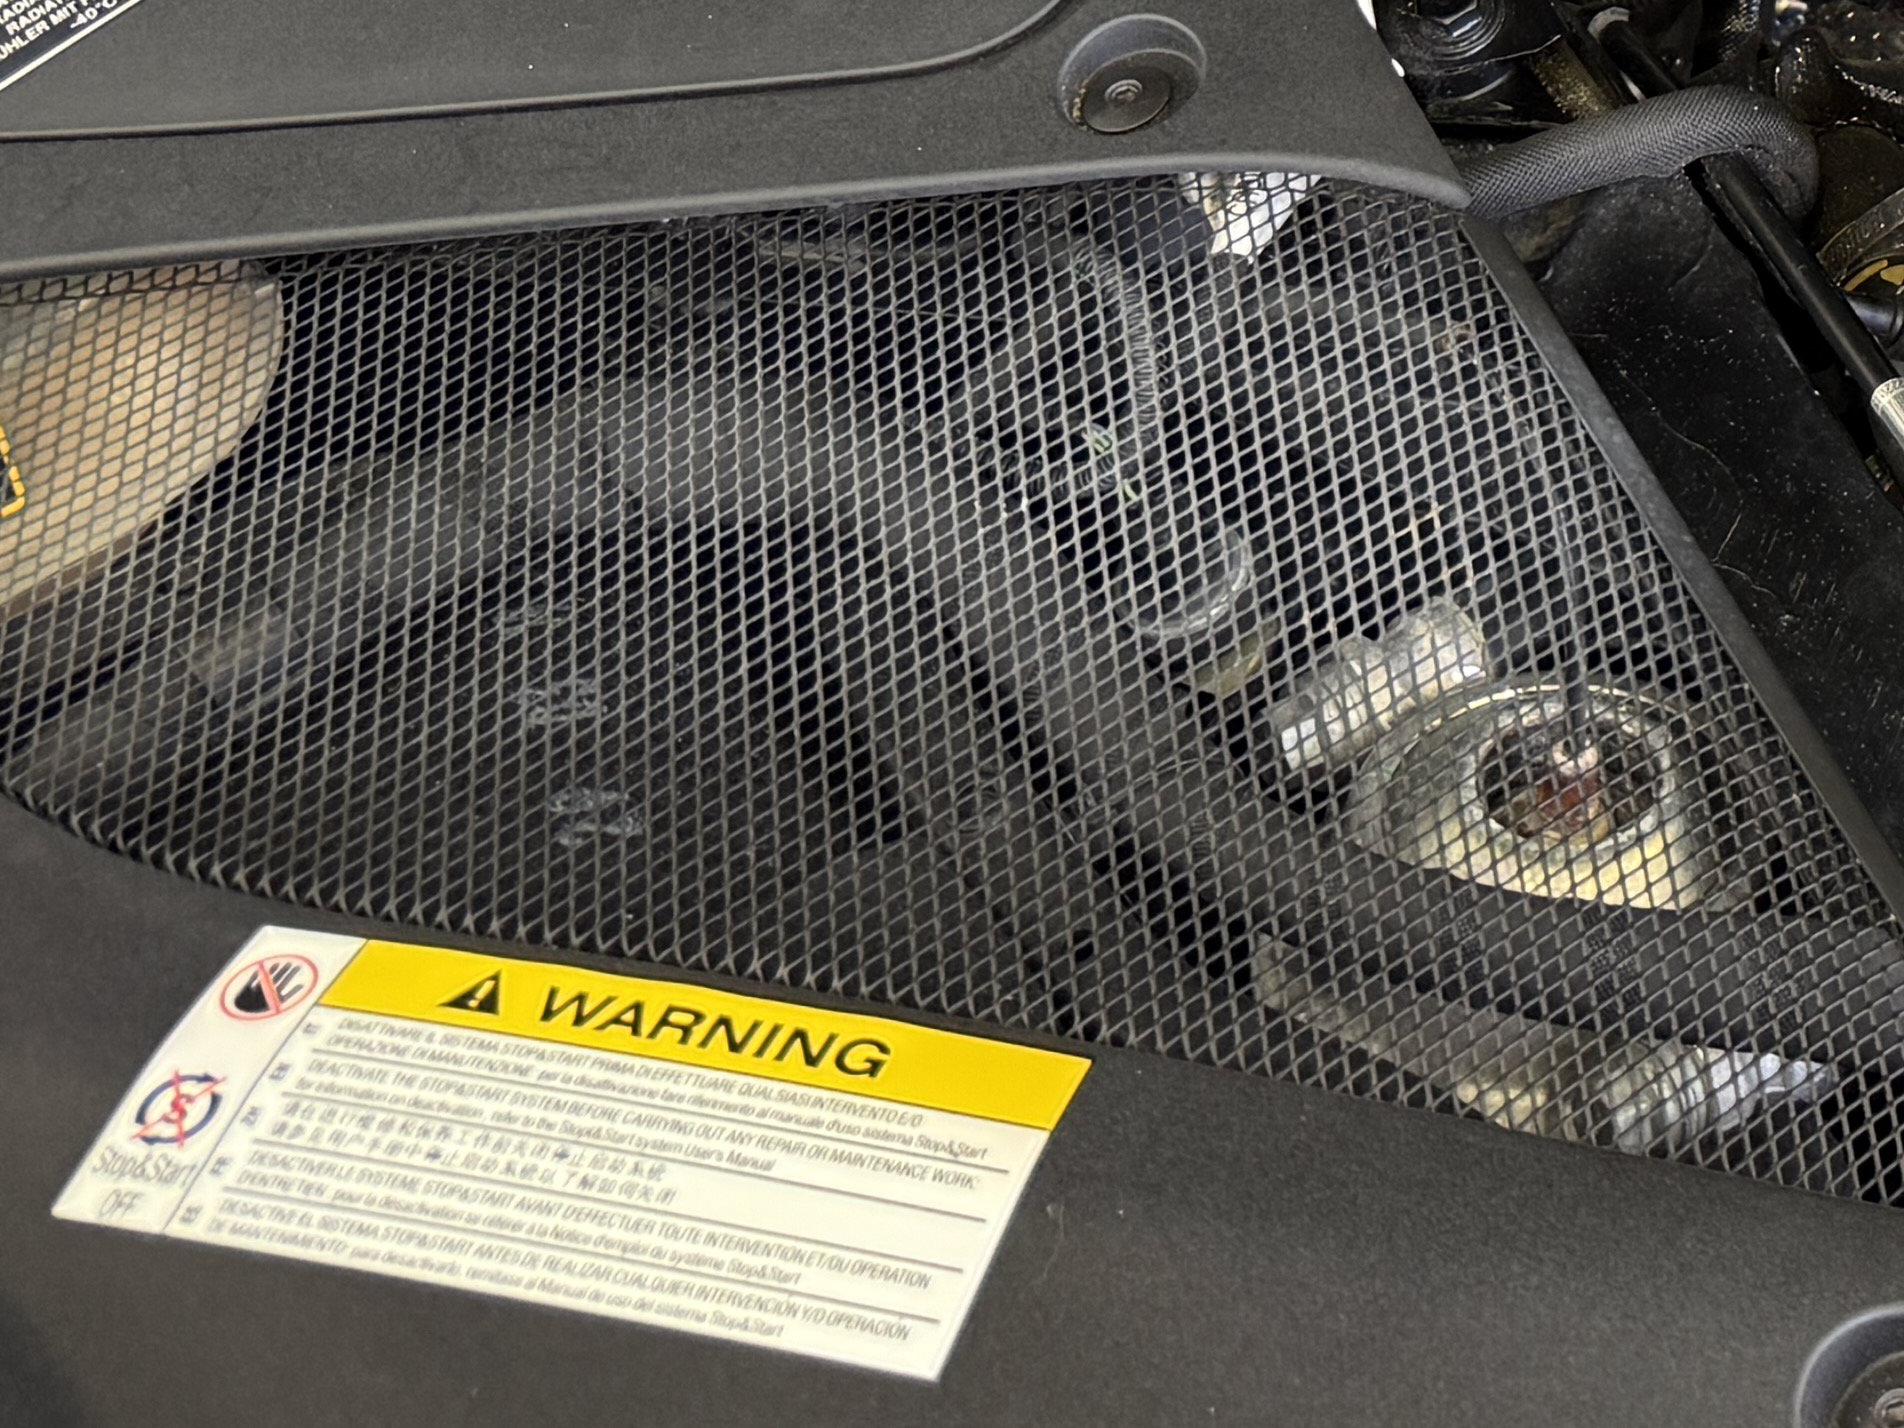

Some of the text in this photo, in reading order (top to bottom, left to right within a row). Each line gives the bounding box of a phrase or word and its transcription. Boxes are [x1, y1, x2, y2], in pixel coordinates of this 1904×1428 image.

[48, 0, 78, 25] MIT
[537, 983, 893, 1081] WARNING
[92, 1146, 198, 1188] Stop&Start
[98, 1189, 144, 1219] OFF
